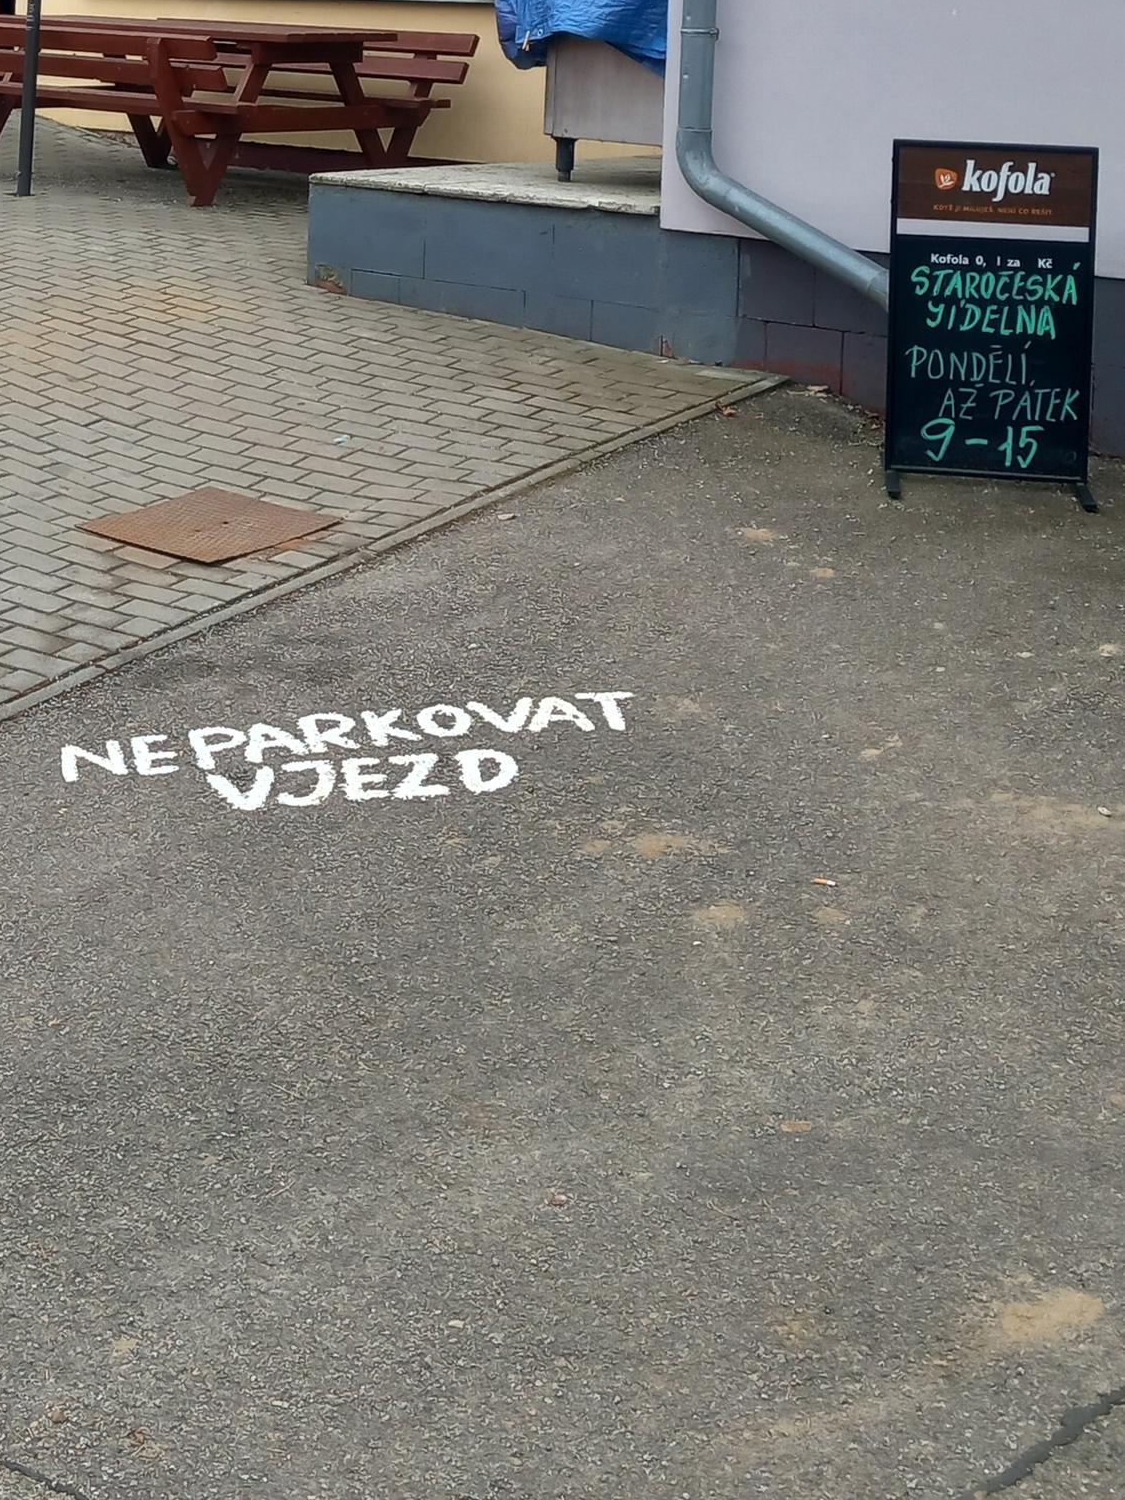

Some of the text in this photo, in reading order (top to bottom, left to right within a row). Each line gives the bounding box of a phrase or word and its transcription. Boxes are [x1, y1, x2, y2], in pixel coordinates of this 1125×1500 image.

[961, 159, 1052, 202] kofola
[930, 253, 970, 265] Kofola
[1006, 259, 1021, 267] za
[1037, 258, 1053, 269] Kč
[910, 262, 1081, 306] STAROČESKÁ
[938, 380, 1081, 422] AŽ PÁTEK
[205, 748, 520, 812] VJEZD
